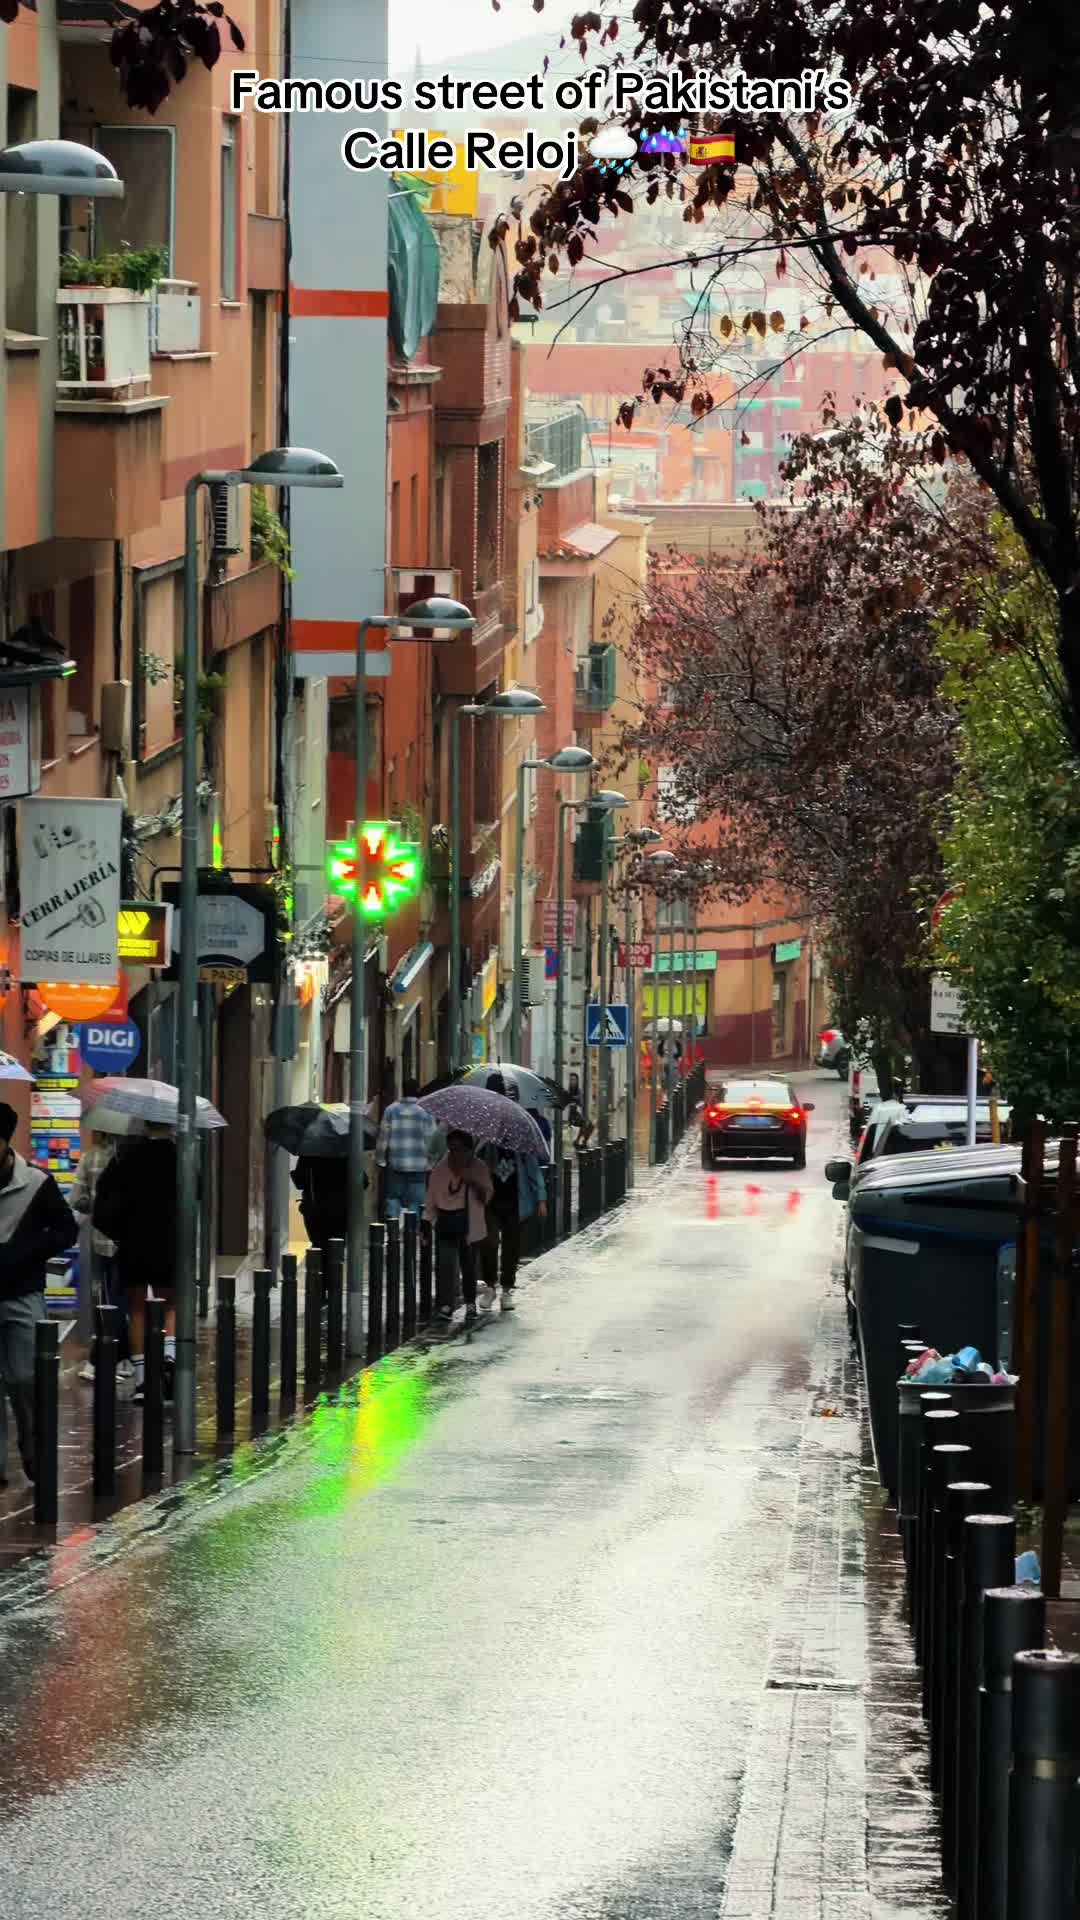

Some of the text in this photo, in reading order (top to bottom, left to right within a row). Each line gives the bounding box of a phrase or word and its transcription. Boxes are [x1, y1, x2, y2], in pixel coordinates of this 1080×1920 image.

[22, 862, 117, 928] CERRAJERÍA
[25, 949, 112, 965] COPIAS DE LLAVES
[211, 969, 245, 981] PASO
[87, 1028, 134, 1048] DIGI
